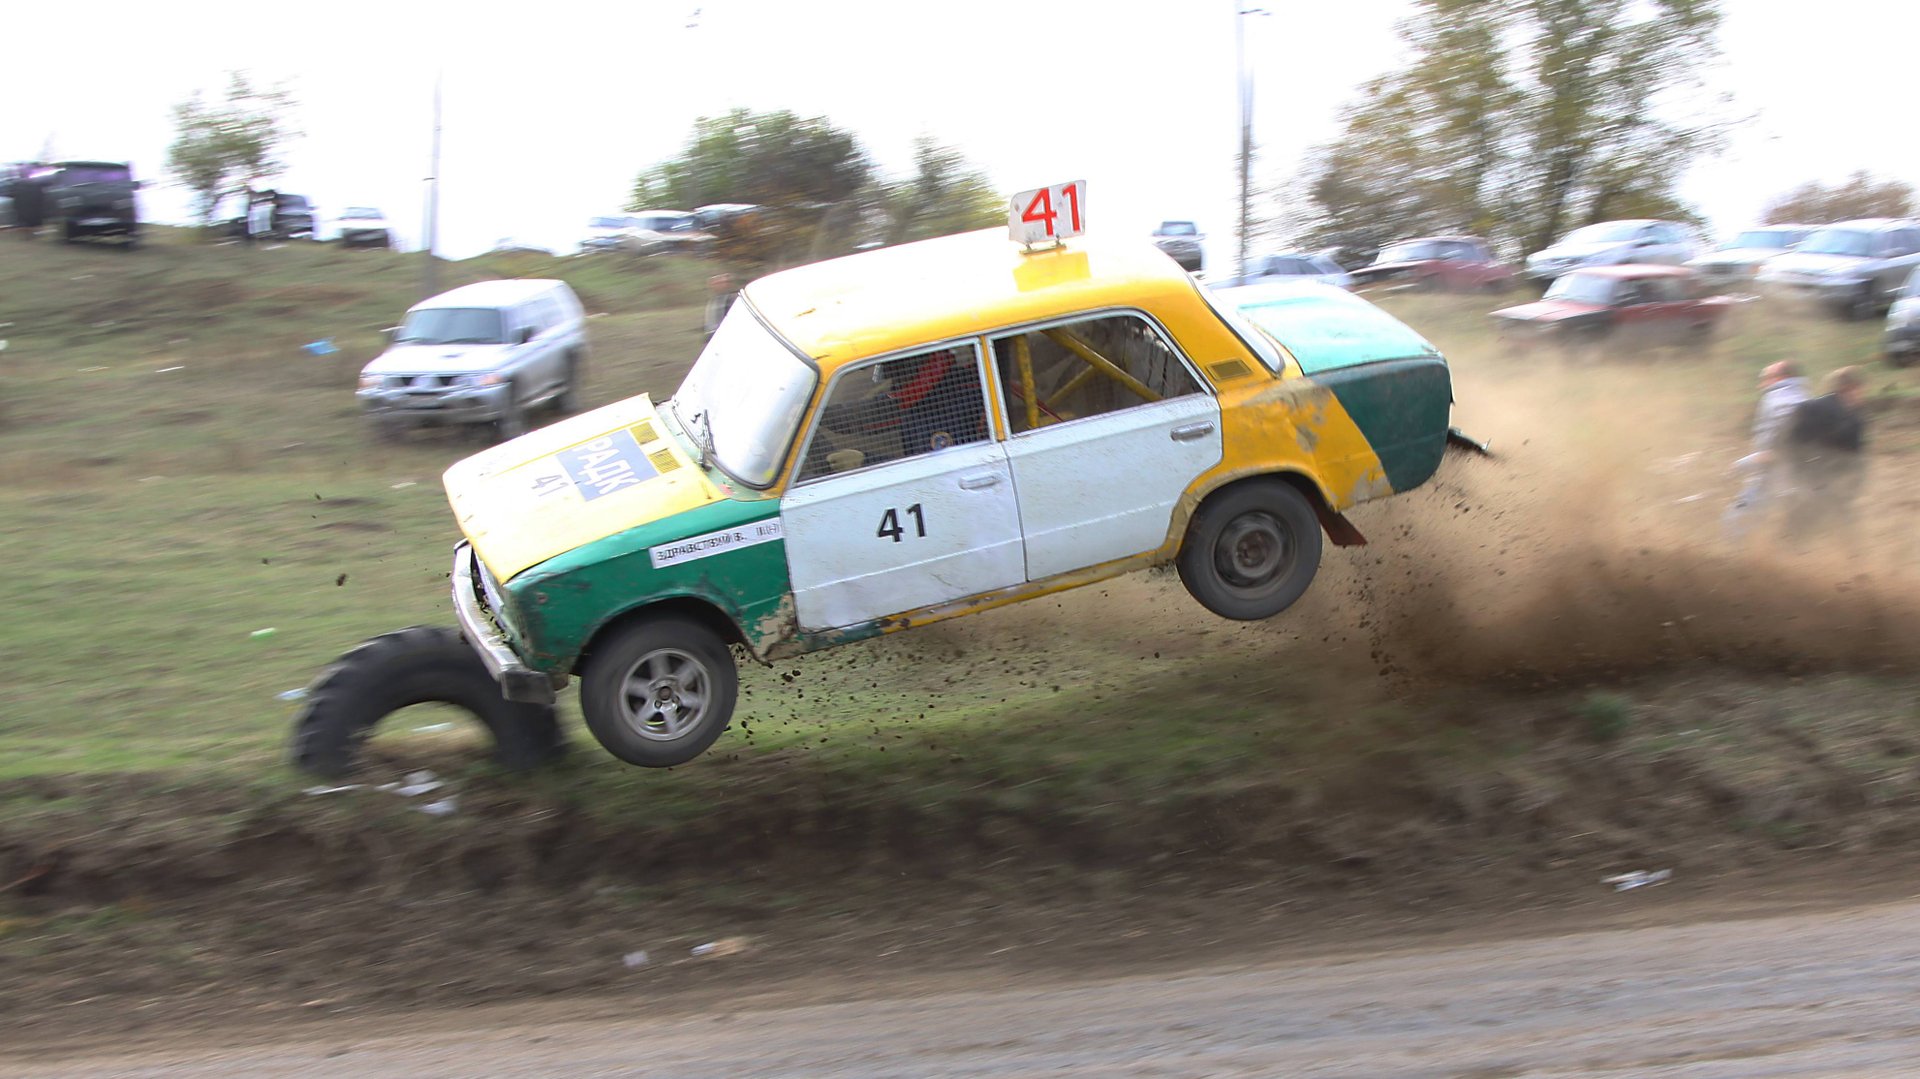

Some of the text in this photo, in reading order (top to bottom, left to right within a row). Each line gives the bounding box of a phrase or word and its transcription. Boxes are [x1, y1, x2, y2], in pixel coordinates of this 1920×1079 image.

[1021, 183, 1080, 236] 41
[531, 474, 569, 497] 41
[571, 436, 641, 495] РАДК
[877, 503, 926, 543] 41
